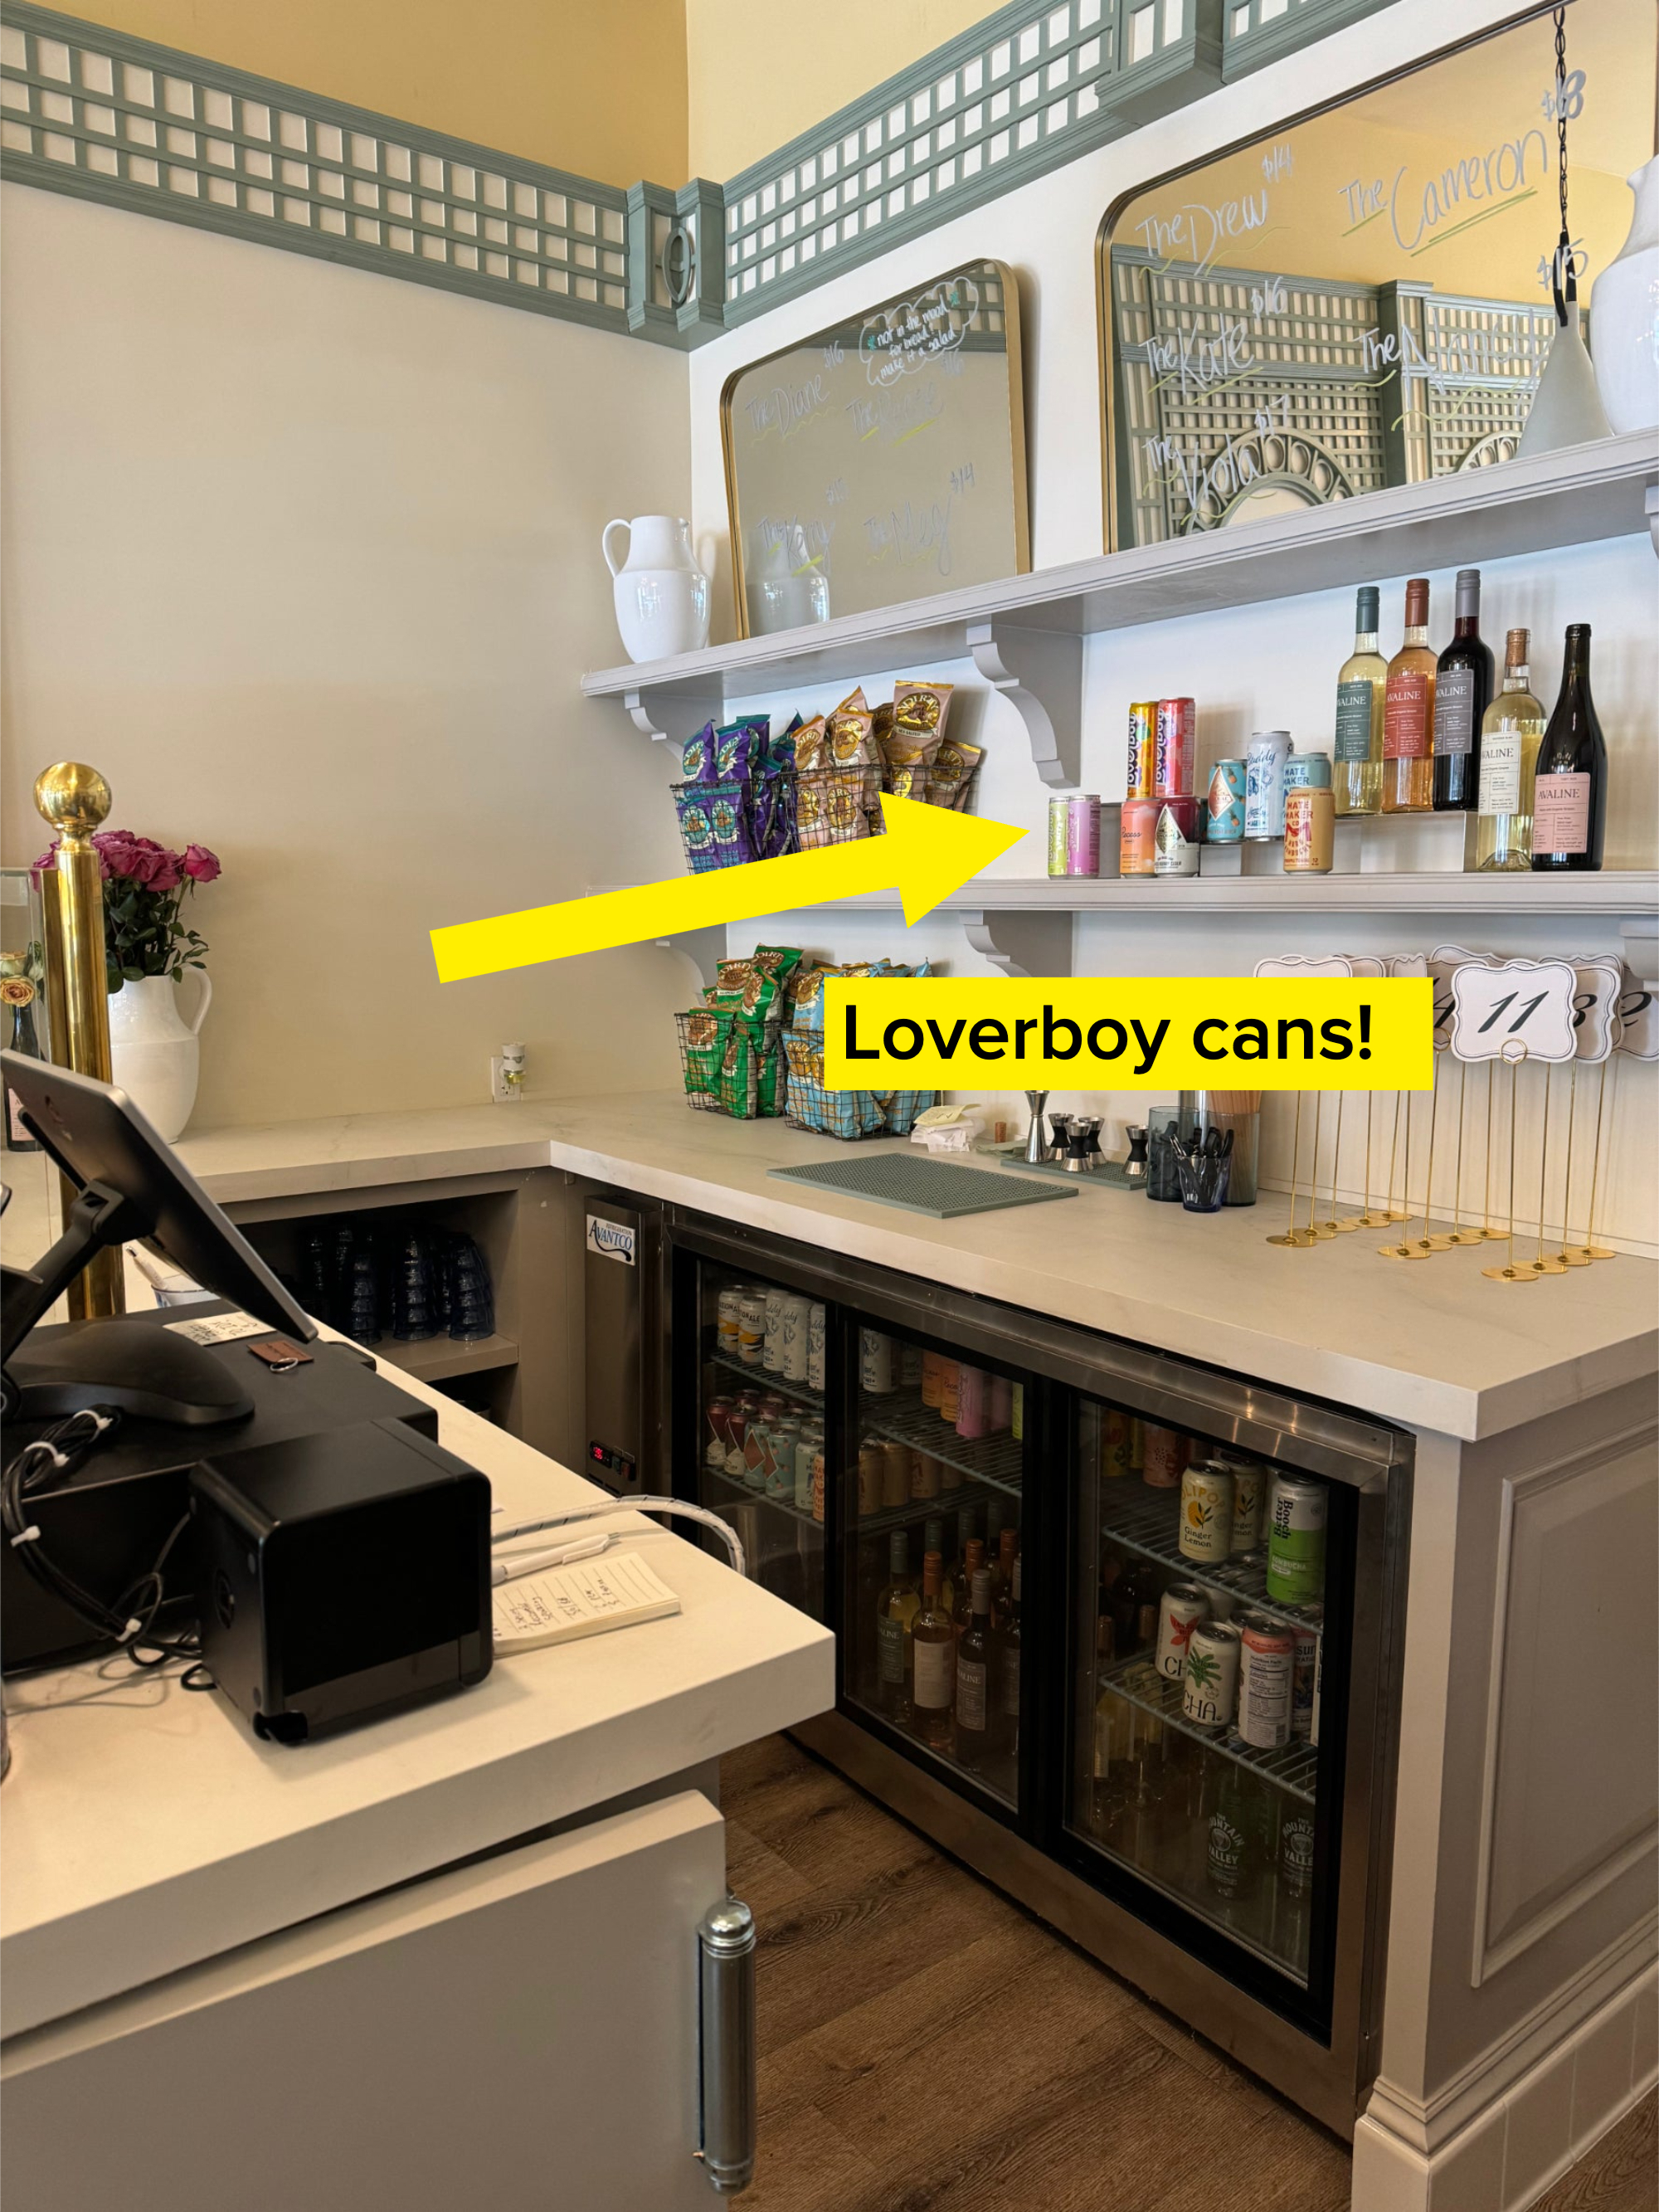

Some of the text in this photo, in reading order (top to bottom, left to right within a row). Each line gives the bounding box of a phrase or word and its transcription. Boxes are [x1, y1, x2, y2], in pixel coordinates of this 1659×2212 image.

[1262, 144, 1294, 183] $14
[1338, 129, 1547, 251] The Cameron
[1135, 189, 1268, 276] The Drew
[1536, 238, 1588, 290] $15
[1251, 276, 1288, 320] $16
[878, 326, 893, 346] not
[897, 324, 905, 337] in
[906, 316, 922, 331] the
[880, 321, 956, 379] make it a salad
[1138, 313, 1254, 395] The Kate
[1352, 308, 1554, 421] The Nancy
[746, 396, 774, 432] The
[771, 374, 830, 436] Diane
[845, 397, 878, 433] The
[1142, 433, 1267, 509] The Viola
[1337, 695, 1367, 707] VALINE
[1285, 767, 1305, 777] MATE
[1287, 801, 1310, 810] MATE
[1538, 788, 1580, 800] AVALINE
[1477, 990, 1550, 1033] 11
[1185, 1527, 1212, 1540] Ginger
[1282, 1499, 1294, 1540] Booch
[1185, 1534, 1211, 1548] Lemon
[1284, 1847, 1314, 1866] VALLE
